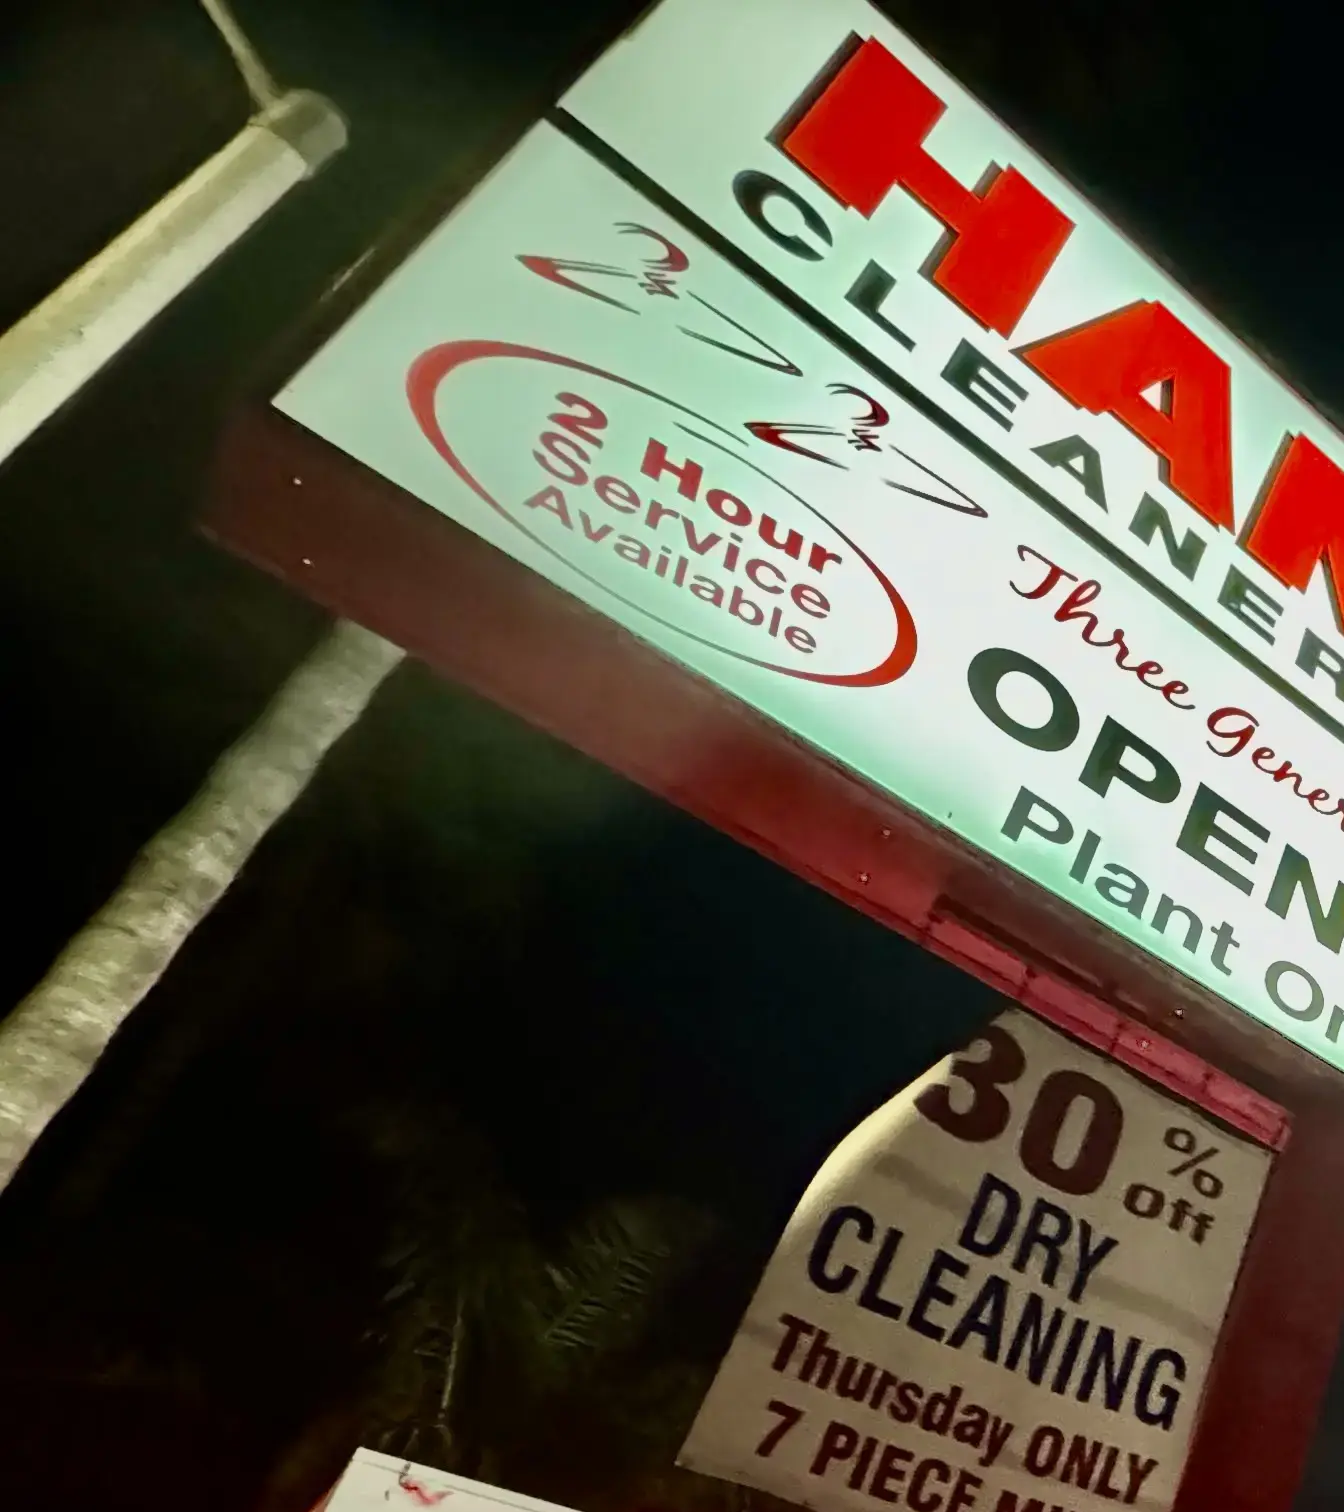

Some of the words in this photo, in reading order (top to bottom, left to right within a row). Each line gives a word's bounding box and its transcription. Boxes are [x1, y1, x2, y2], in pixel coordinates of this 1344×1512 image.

[523, 485, 817, 654] Available
[532, 431, 831, 619] Service
[547, 392, 608, 449] 2
[640, 437, 843, 574] Hour
[1009, 545, 1196, 710] Three
[1000, 785, 1240, 976] Plant
[914, 1025, 1124, 1197] 30
[1163, 1126, 1224, 1200] %
[806, 1205, 1188, 1431] CLEANING
[958, 1173, 1119, 1303] DRY
[753, 1401, 805, 1458] 7
[770, 1314, 1017, 1466] Thursday
[1024, 1423, 1159, 1506] ONLY
